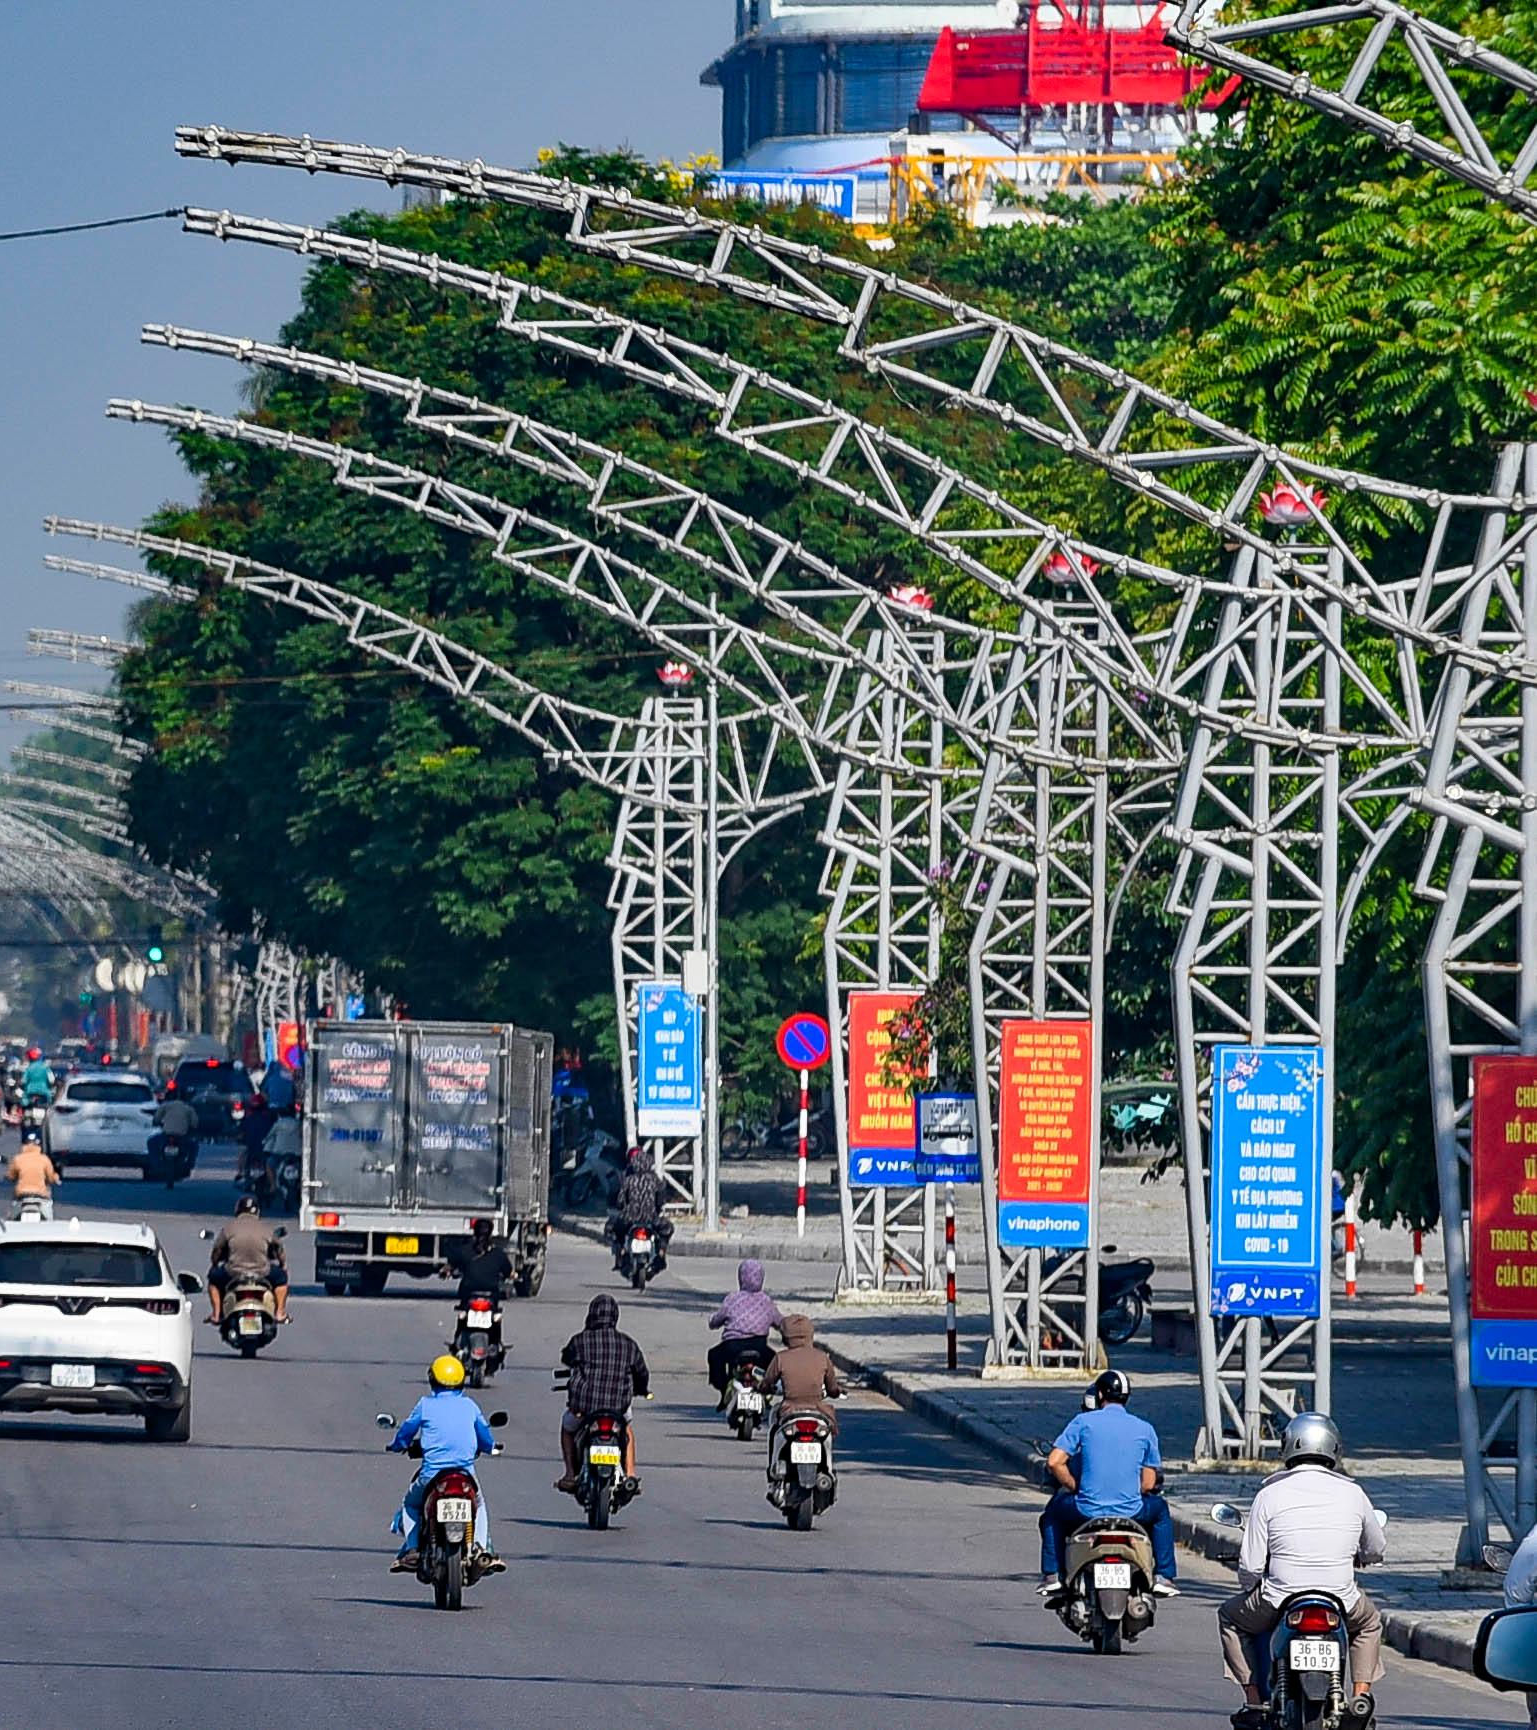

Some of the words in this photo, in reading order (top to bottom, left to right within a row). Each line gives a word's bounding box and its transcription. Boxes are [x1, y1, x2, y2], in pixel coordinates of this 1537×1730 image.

[1524, 1122, 1537, 1144] CH
[876, 1161, 911, 1172] VNP
[1513, 1187, 1537, 1216] SỐN
[1008, 1216, 1080, 1232] vinaphone
[1490, 1229, 1528, 1252] TRONG
[1530, 1229, 1537, 1252] S
[1495, 1259, 1519, 1288] CỦA
[1522, 1266, 1537, 1288] CH
[1249, 1287, 1304, 1301] VNPT
[1485, 1342, 1537, 1365] vinap
